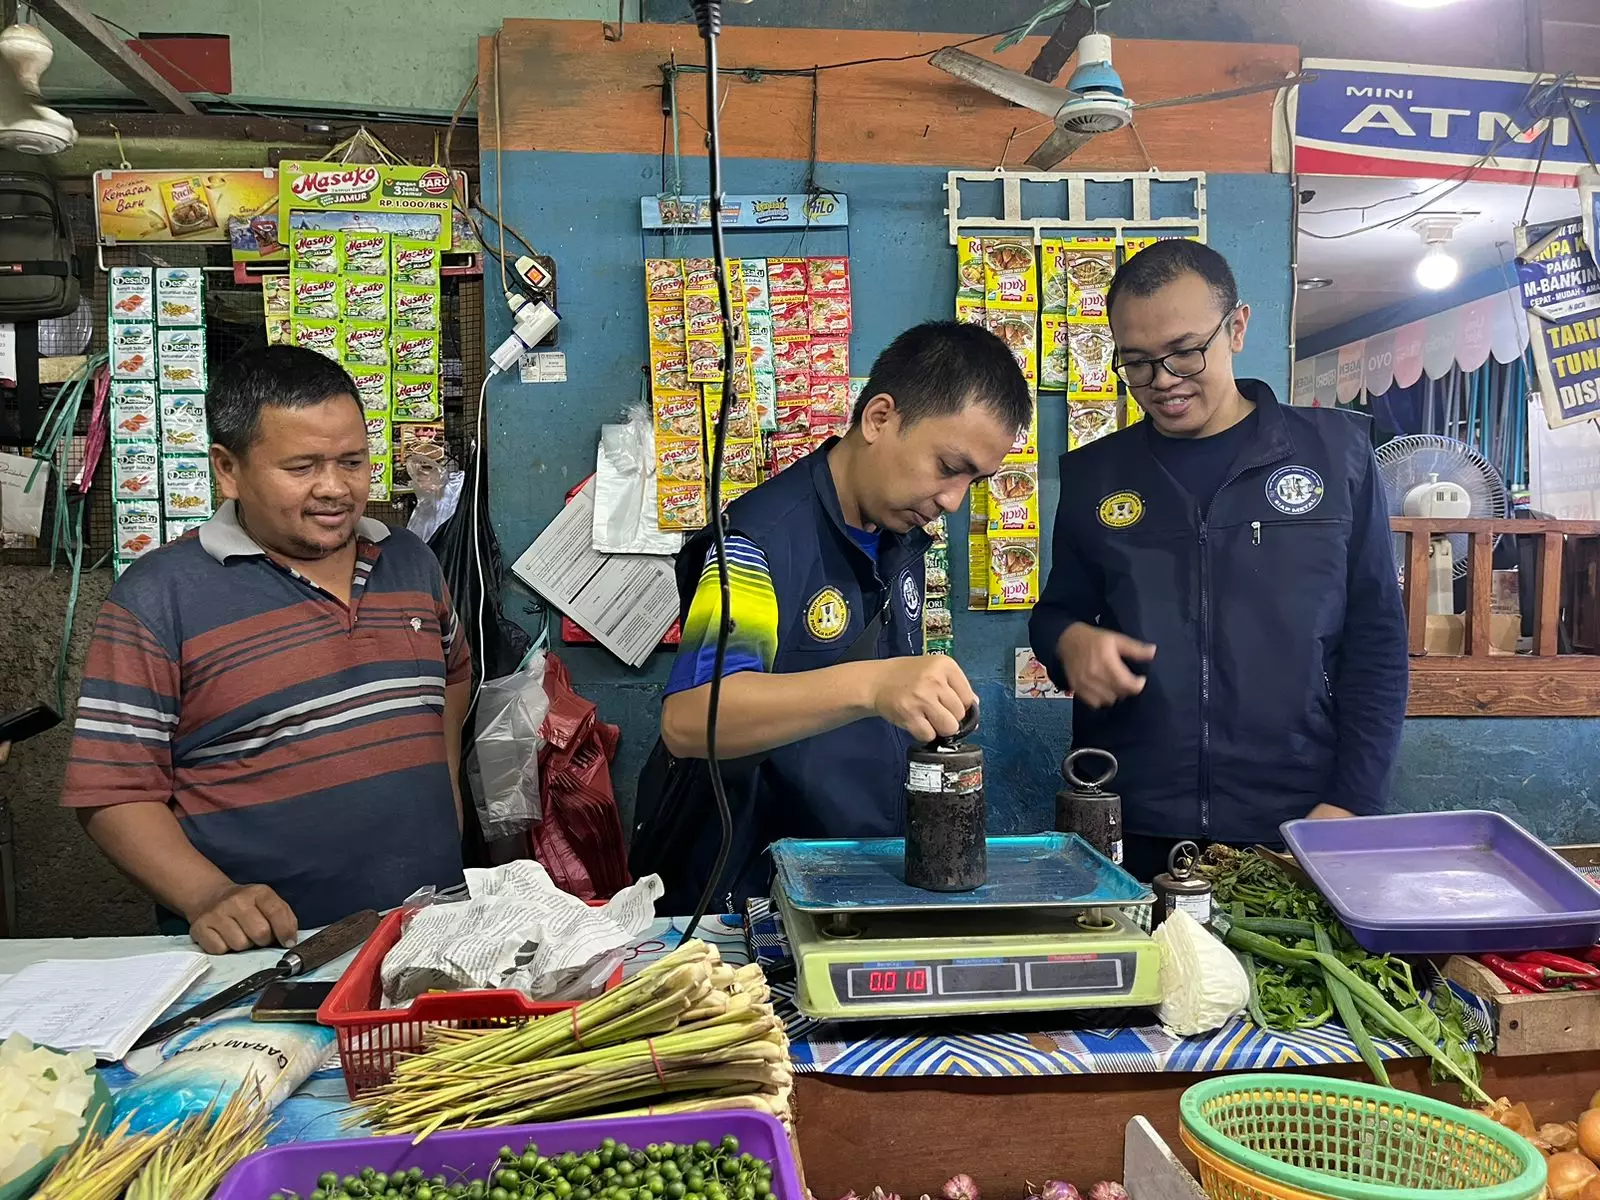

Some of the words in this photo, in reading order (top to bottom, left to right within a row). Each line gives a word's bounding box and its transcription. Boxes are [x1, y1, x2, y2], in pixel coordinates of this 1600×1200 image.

[1345, 85, 1414, 100] MINI
[1340, 103, 1570, 147] ATM
[291, 166, 377, 195] Masako
[418, 177, 450, 188] BARU
[102, 185, 152, 203] Kemasan
[333, 192, 368, 204] JAMUR
[393, 186, 402, 196] 3
[115, 199, 145, 213] Baru
[294, 234, 335, 250] Masako
[344, 236, 384, 252] Masako
[1546, 257, 1582, 275] PAKAI
[295, 280, 335, 296] Masako
[997, 279, 1027, 294] Racik
[1523, 267, 1600, 298] M-BANKIN
[1079, 294, 1107, 309] Racik
[1529, 295, 1552, 307] CEPAT
[1555, 288, 1581, 302] MUDAH
[1546, 316, 1600, 349] TARI
[657, 399, 695, 418] Masako
[659, 447, 698, 463] Masako
[661, 491, 700, 509] Masako
[1000, 507, 1029, 524] Racik
[1001, 582, 1030, 598] Racik
[869, 970, 926, 992] 0.010
[223, 1039, 289, 1070] GARAM
